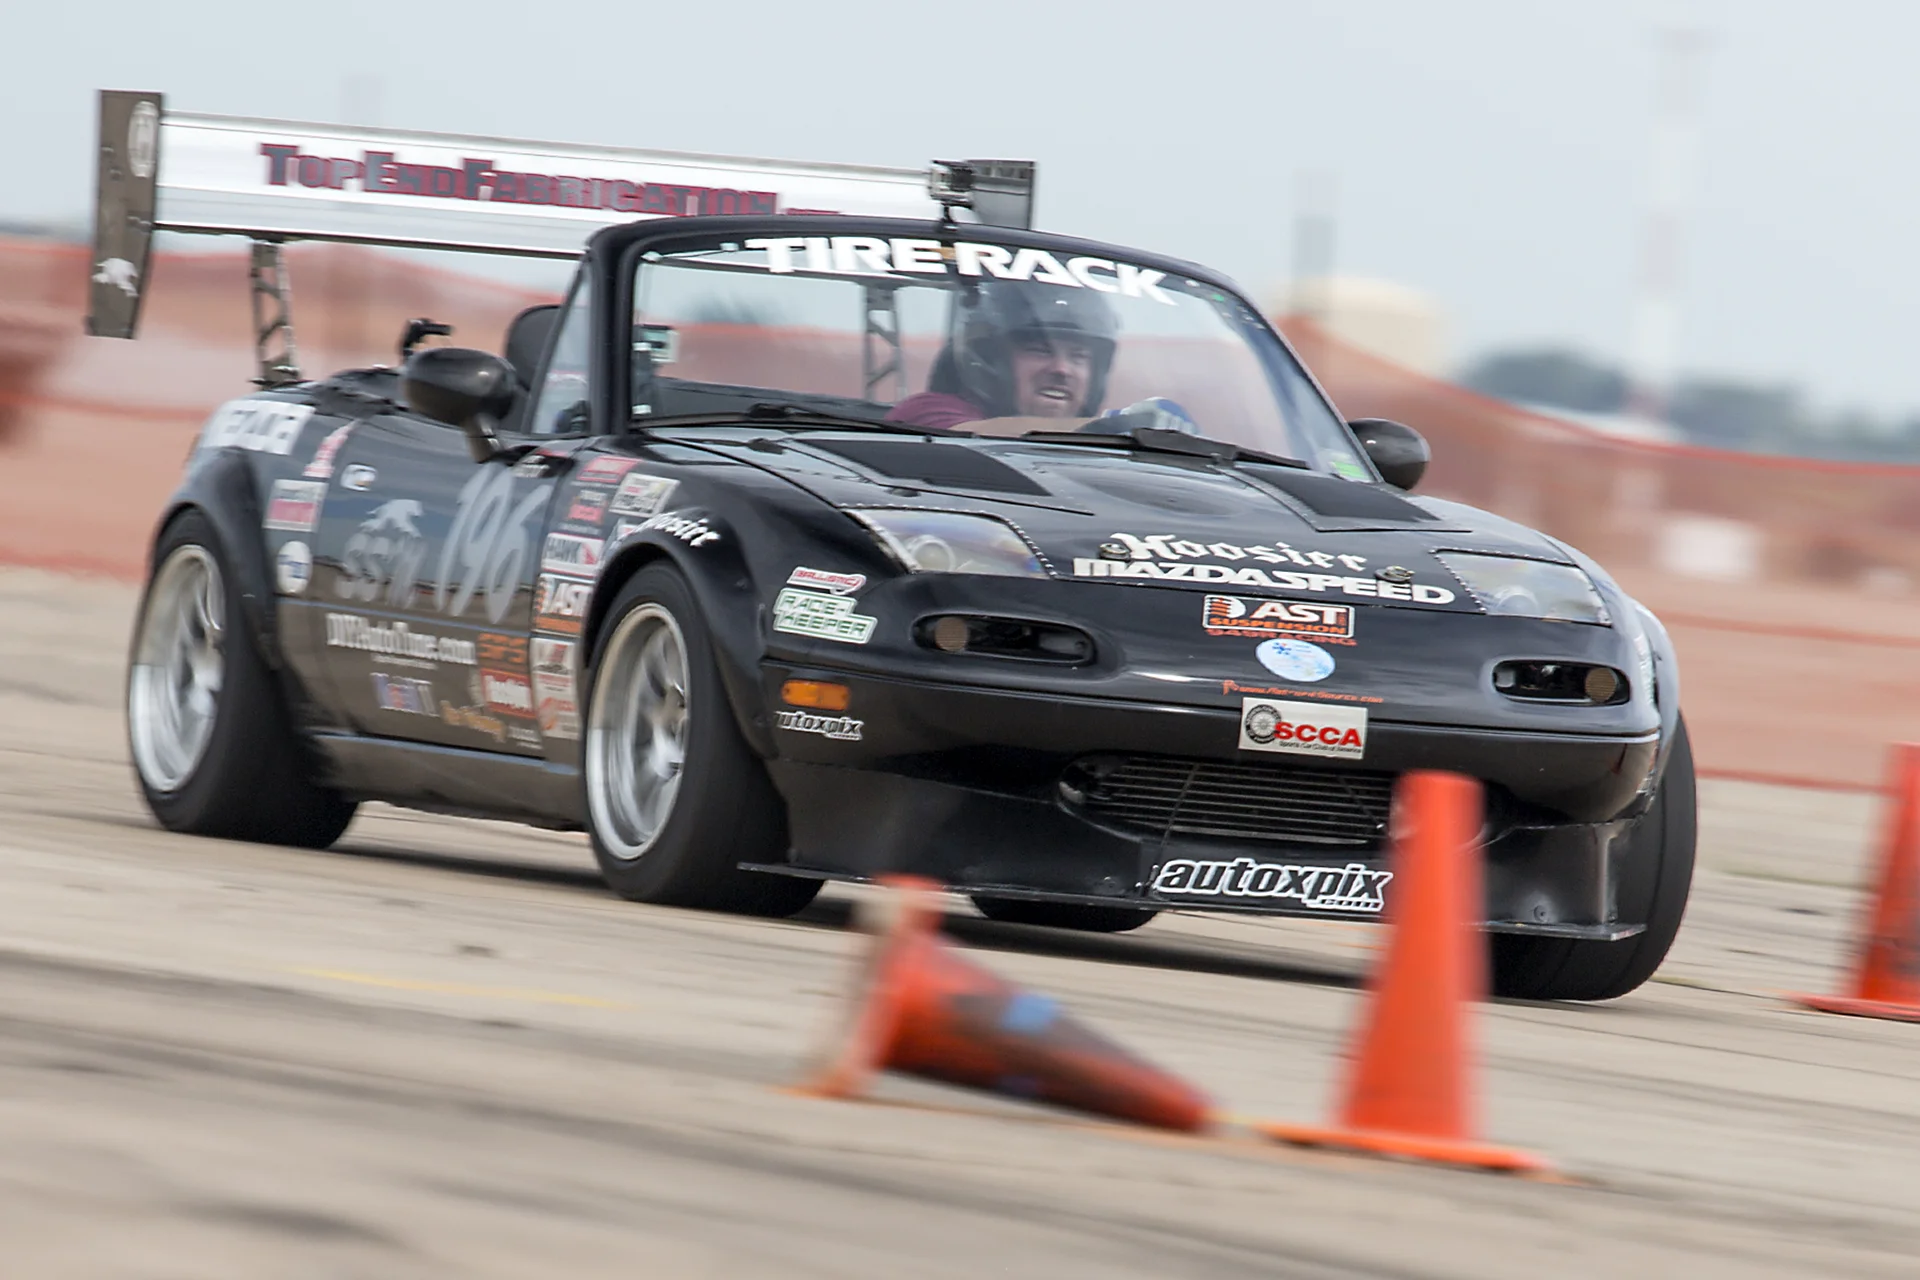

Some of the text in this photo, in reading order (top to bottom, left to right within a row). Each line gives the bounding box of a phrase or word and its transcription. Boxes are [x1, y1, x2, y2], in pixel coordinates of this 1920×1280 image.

[1109, 532, 1368, 572] Hoosier
[1073, 558, 1456, 604] MAZDASPEED
[1209, 617, 1346, 635] SUSPENSION
[1250, 602, 1347, 625] AST
[1273, 721, 1363, 748] SCCA
[1156, 858, 1393, 901] autoxpix
